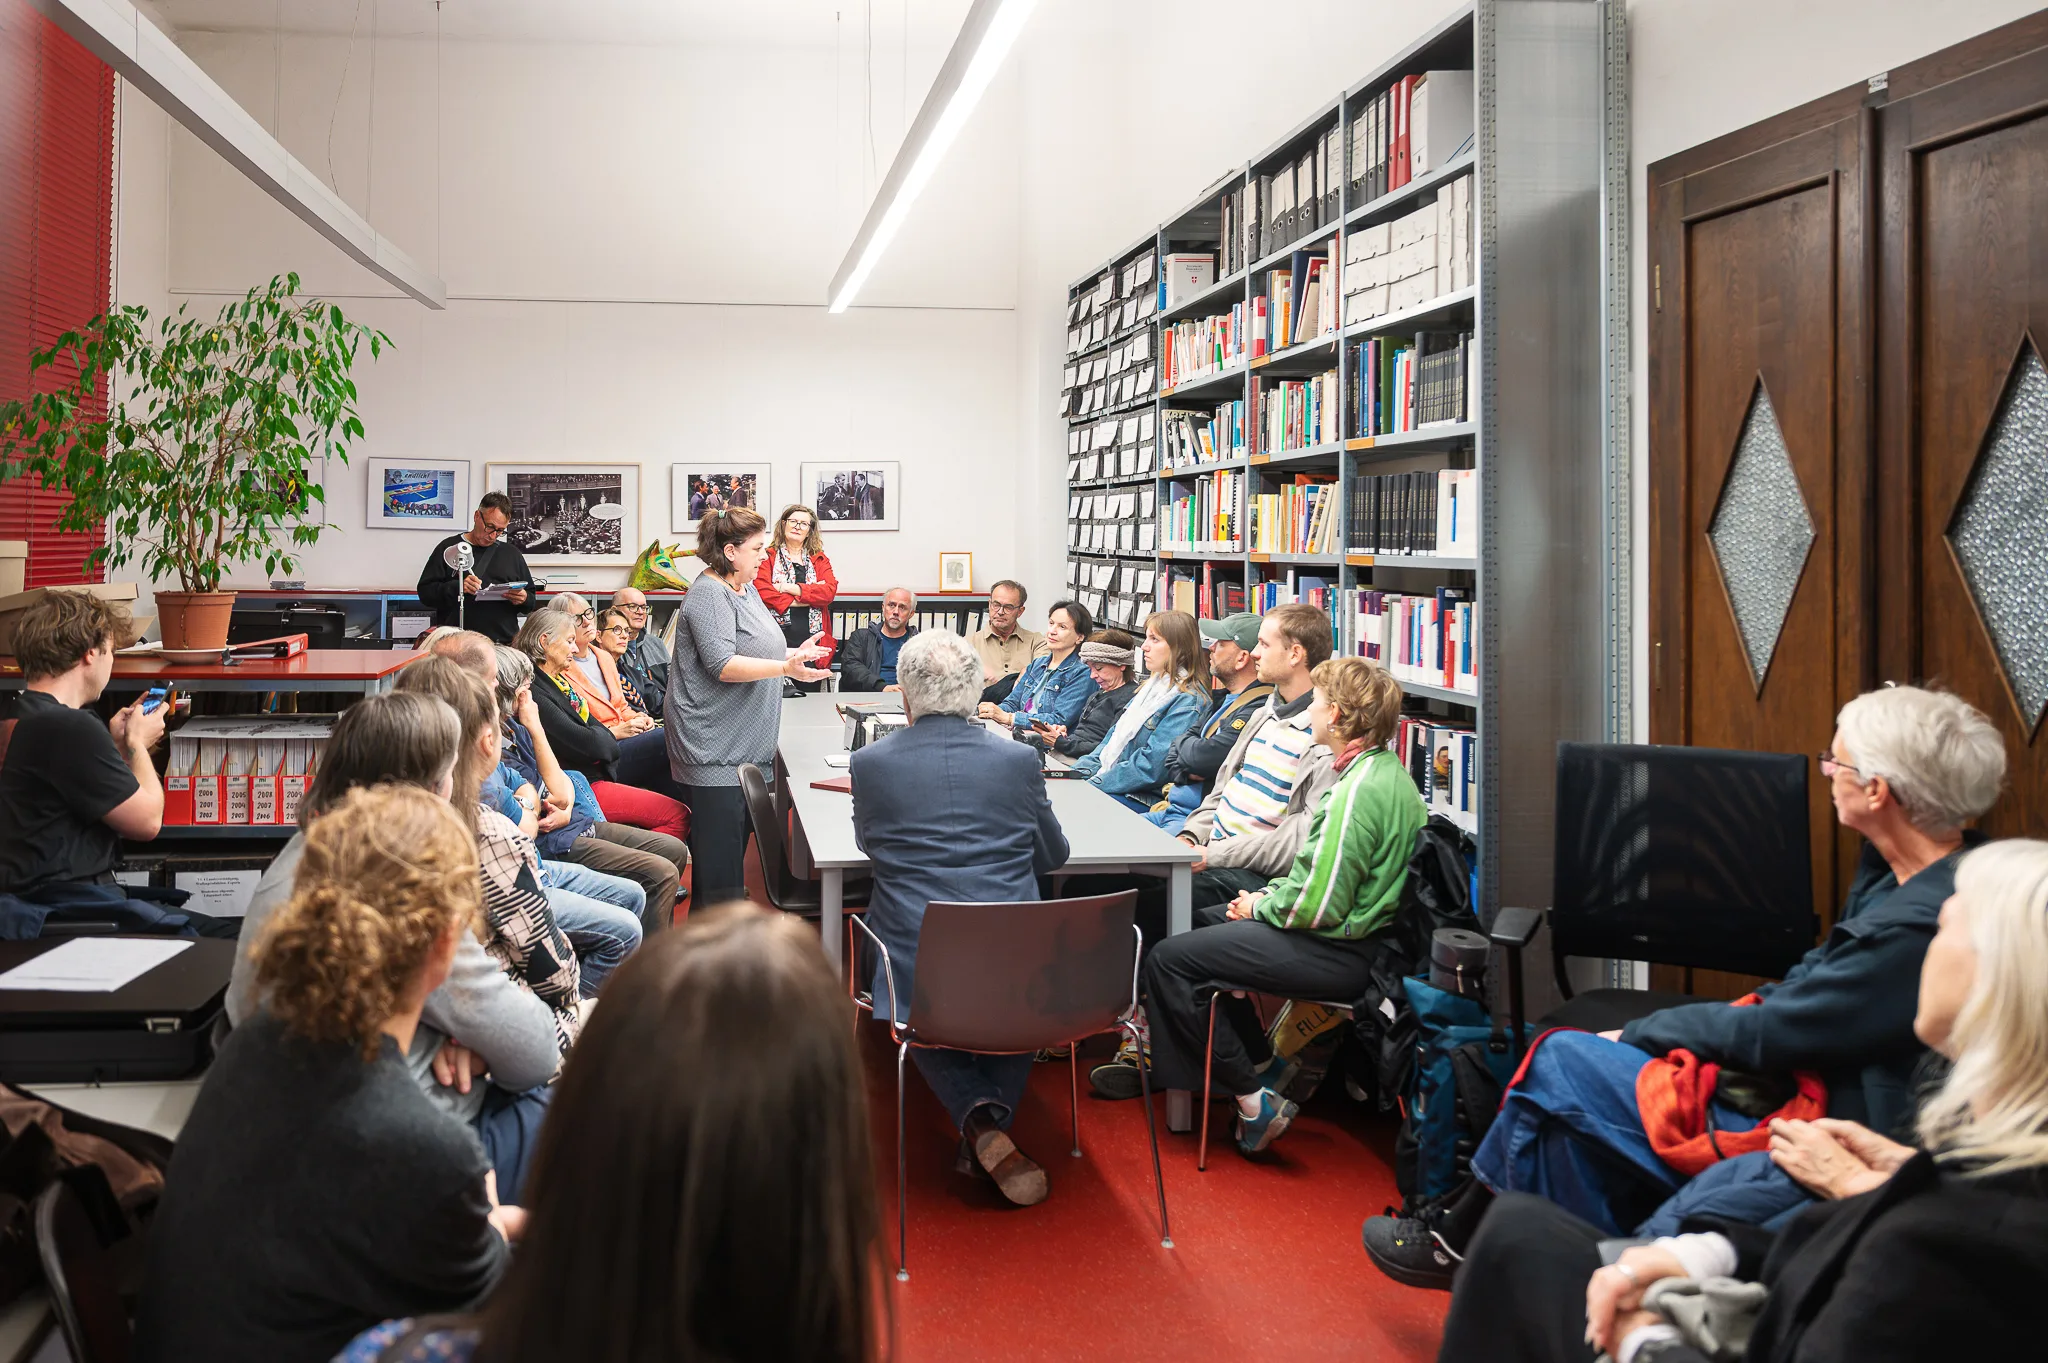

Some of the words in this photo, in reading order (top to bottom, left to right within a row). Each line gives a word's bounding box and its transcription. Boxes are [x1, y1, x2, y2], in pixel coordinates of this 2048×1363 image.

[1423, 751, 1432, 800] AUSTRIA
[231, 791, 247, 799] 2005
[257, 791, 273, 799] 2008
[286, 791, 303, 799] 2009
[256, 812, 271, 820] 2006
